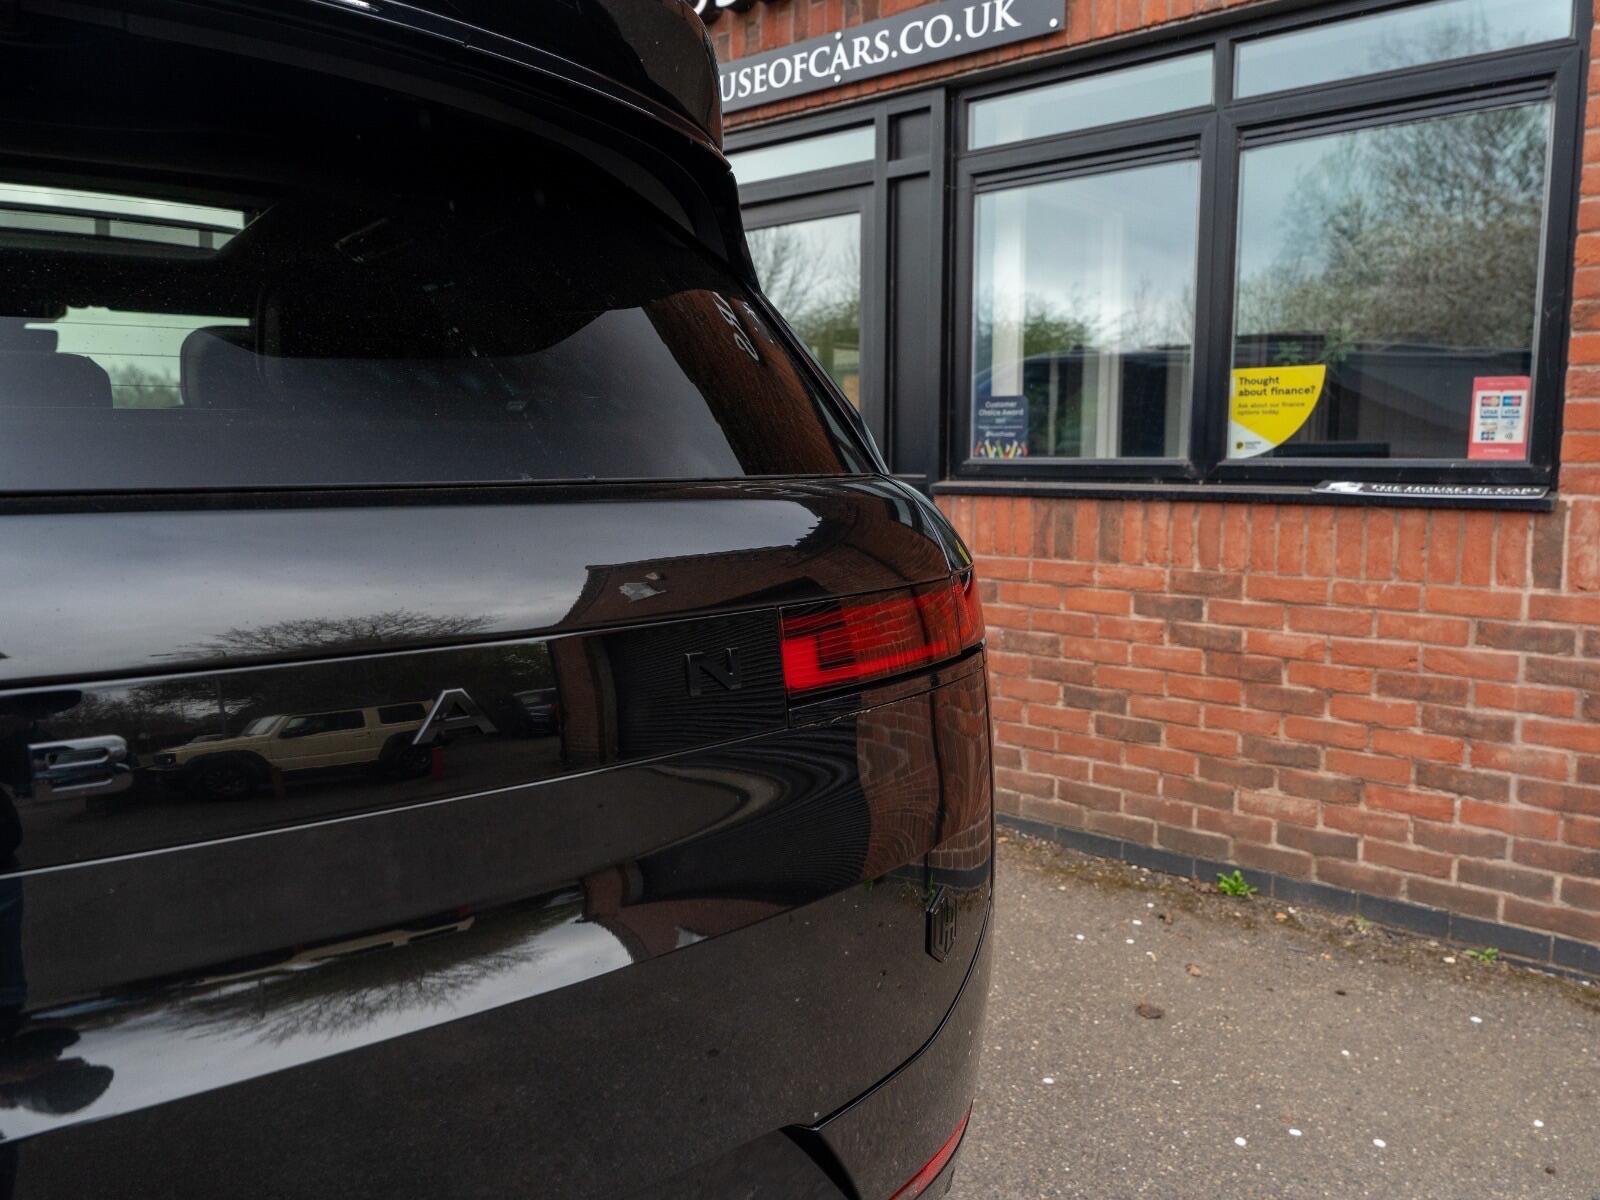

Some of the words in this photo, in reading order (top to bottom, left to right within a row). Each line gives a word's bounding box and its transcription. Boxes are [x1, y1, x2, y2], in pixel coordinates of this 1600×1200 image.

[1239, 376, 1280, 386] Thought
[1238, 388, 1267, 396] about
[1271, 385, 1316, 395] finance?
[1002, 408, 1024, 416] Award
